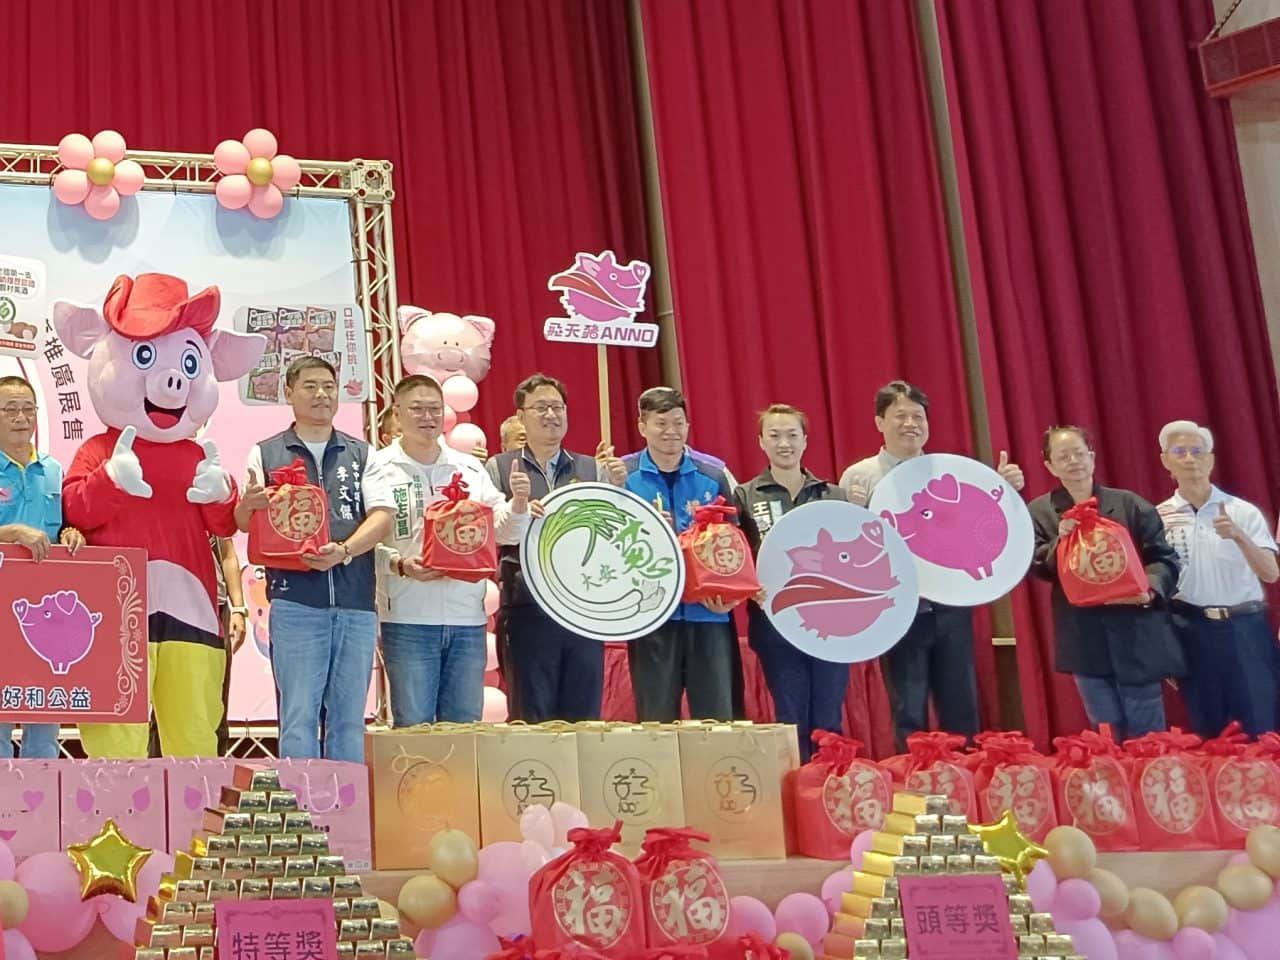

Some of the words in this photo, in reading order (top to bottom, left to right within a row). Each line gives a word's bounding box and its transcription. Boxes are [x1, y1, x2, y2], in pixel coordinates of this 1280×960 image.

[563, 869, 624, 938] 福
[661, 860, 722, 937] 福
[913, 903, 1001, 936] 頭等獎
[231, 931, 323, 960] 特等獎
